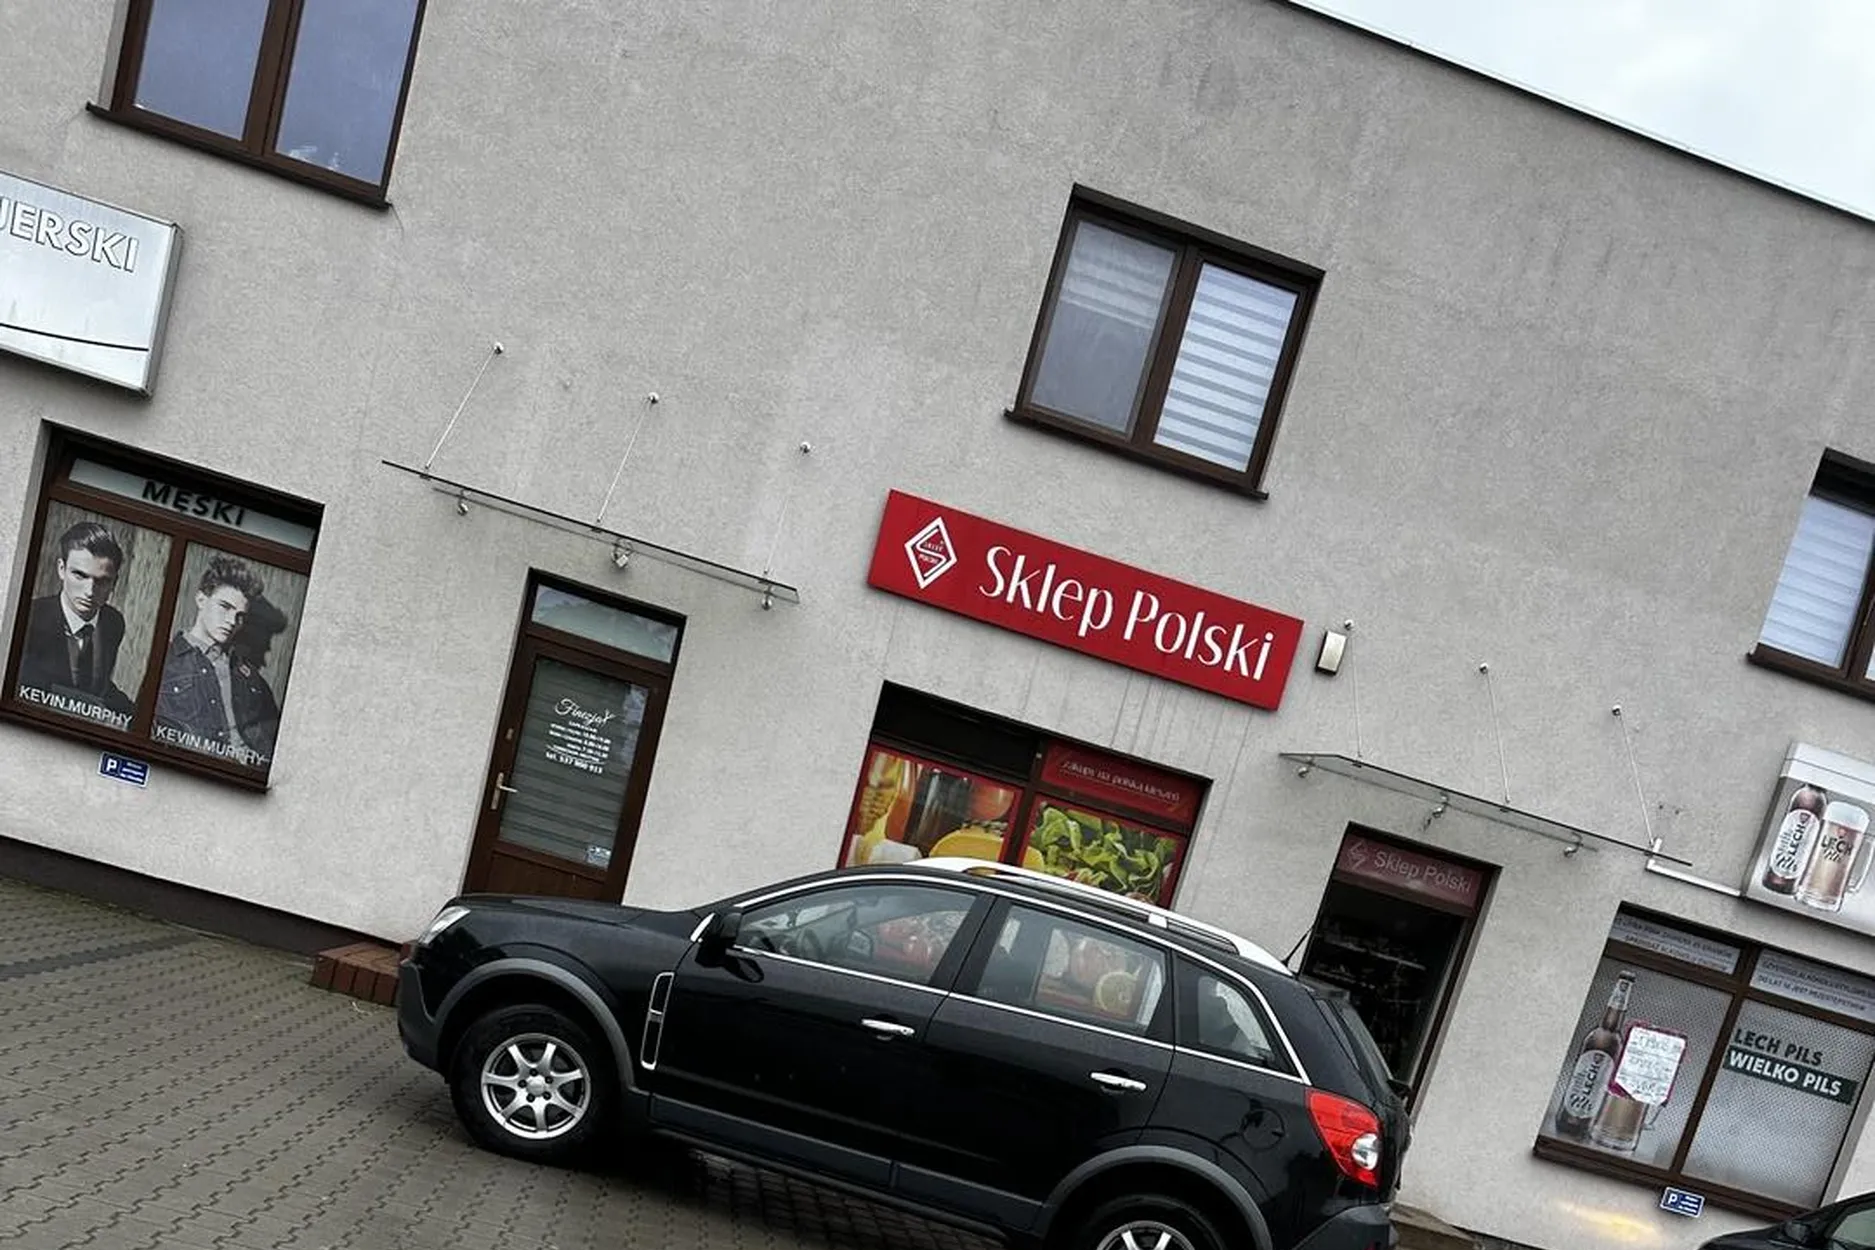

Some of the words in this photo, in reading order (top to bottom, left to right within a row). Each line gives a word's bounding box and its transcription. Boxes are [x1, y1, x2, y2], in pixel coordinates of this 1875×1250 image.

[979, 546, 1113, 637] Sklep
[1123, 590, 1274, 680] Polski
[19, 685, 133, 731] KEVIN.MURPHY
[106, 758, 117, 771] P
[1788, 824, 1806, 856] LECH
[1821, 835, 1853, 856] LECH
[1374, 850, 1420, 879] Sklep
[1423, 864, 1472, 893] Polski
[1734, 1029, 1780, 1054] LECH
[1785, 1043, 1823, 1066] PILS
[1583, 1063, 1600, 1095] LECH
[1729, 1050, 1800, 1083] WIELKO
[1802, 1072, 1842, 1096] PILS
[1667, 1193, 1678, 1204] P
